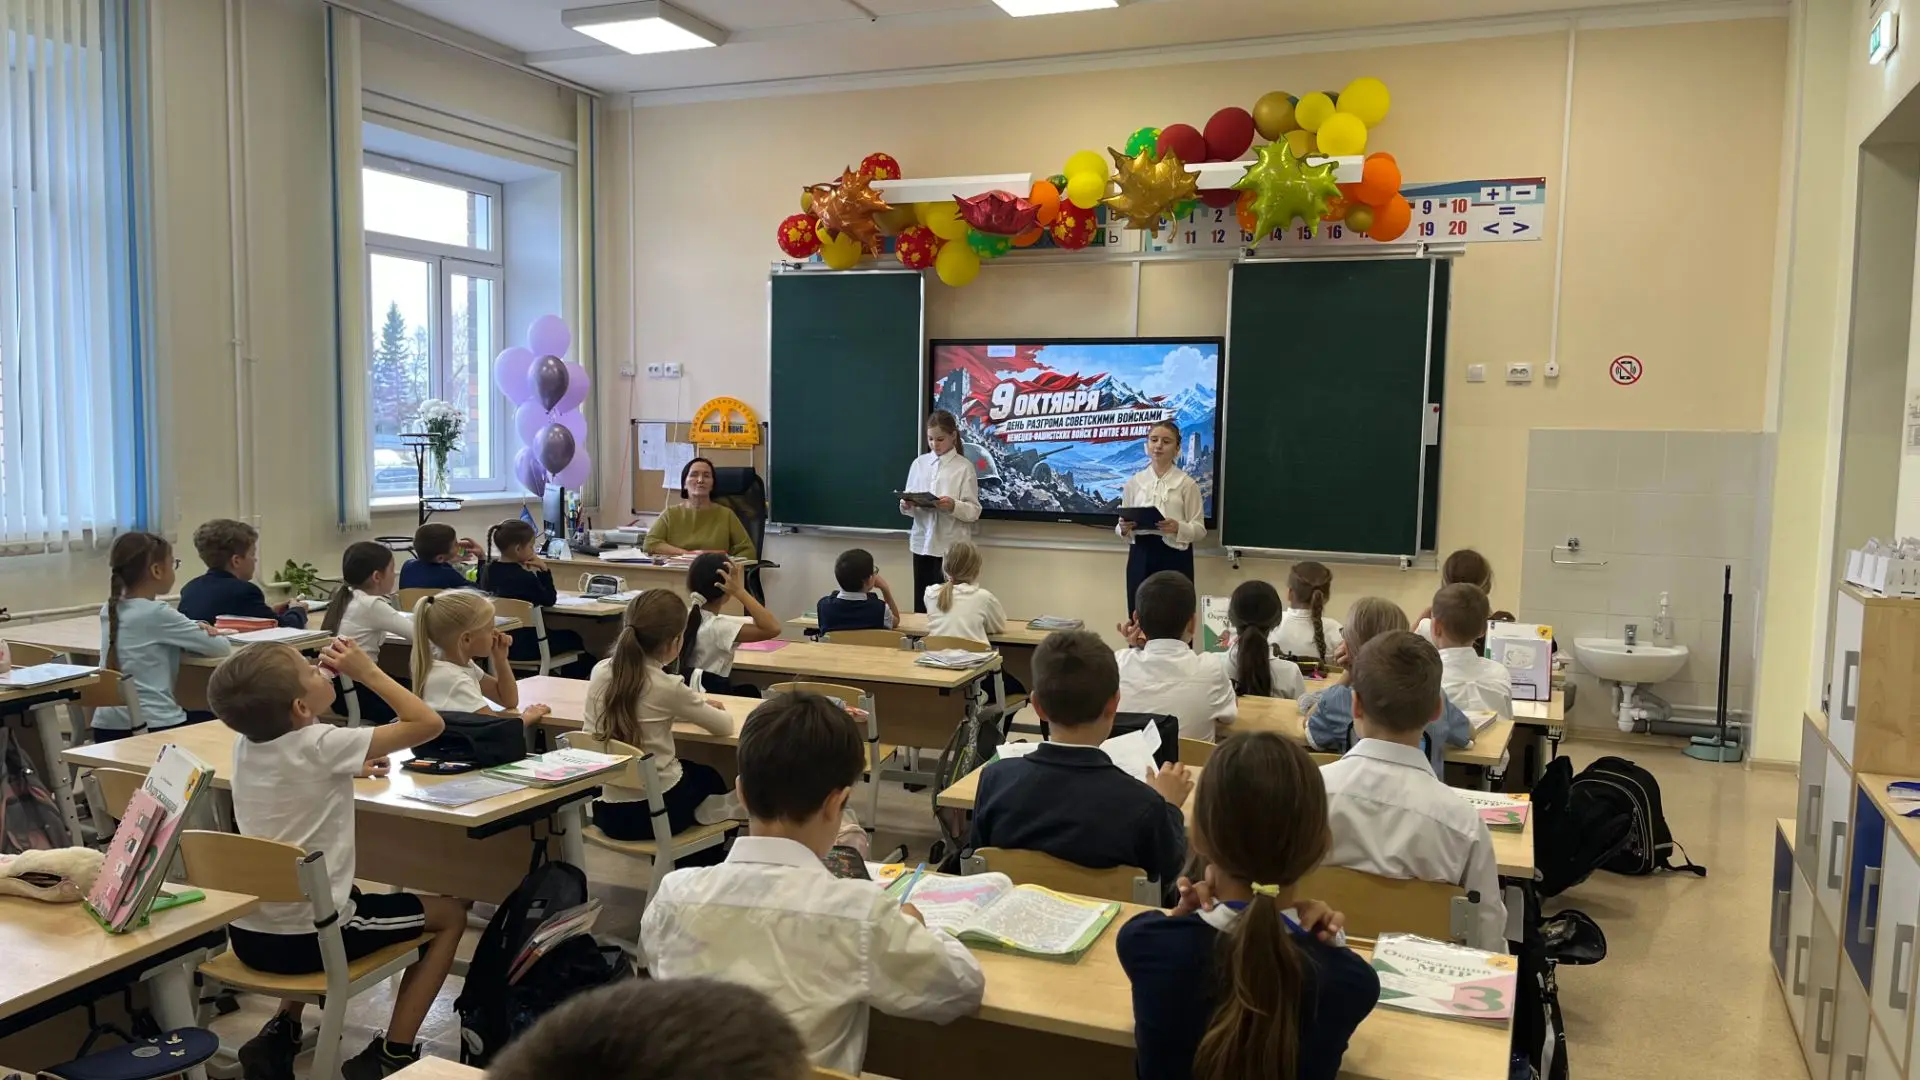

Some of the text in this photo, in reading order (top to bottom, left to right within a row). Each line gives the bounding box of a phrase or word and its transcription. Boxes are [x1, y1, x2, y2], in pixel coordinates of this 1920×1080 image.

[1214, 209, 1223, 223] 2
[1422, 200, 1432, 215] 9
[1451, 198, 1468, 214] 10
[1184, 230, 1196, 244] 11
[1211, 229, 1226, 243] 12
[1297, 226, 1312, 240] 15
[1326, 225, 1342, 239] 16
[1418, 221, 1435, 236] 19
[1448, 220, 1468, 236] 20
[989, 382, 1101, 421] 9 ОКТЯБРЯ
[1006, 410, 1162, 431] ДЕНЬ РАЗГРОМА СОВЕТСКИМИ ВОЙСКАМИ
[1071, 429, 1092, 439] ВОЙСК
[1093, 428, 1099, 437] В
[1101, 427, 1120, 437] БИТВЕ
[1121, 427, 1129, 436] ЗА
[1451, 985, 1506, 1012] 3
